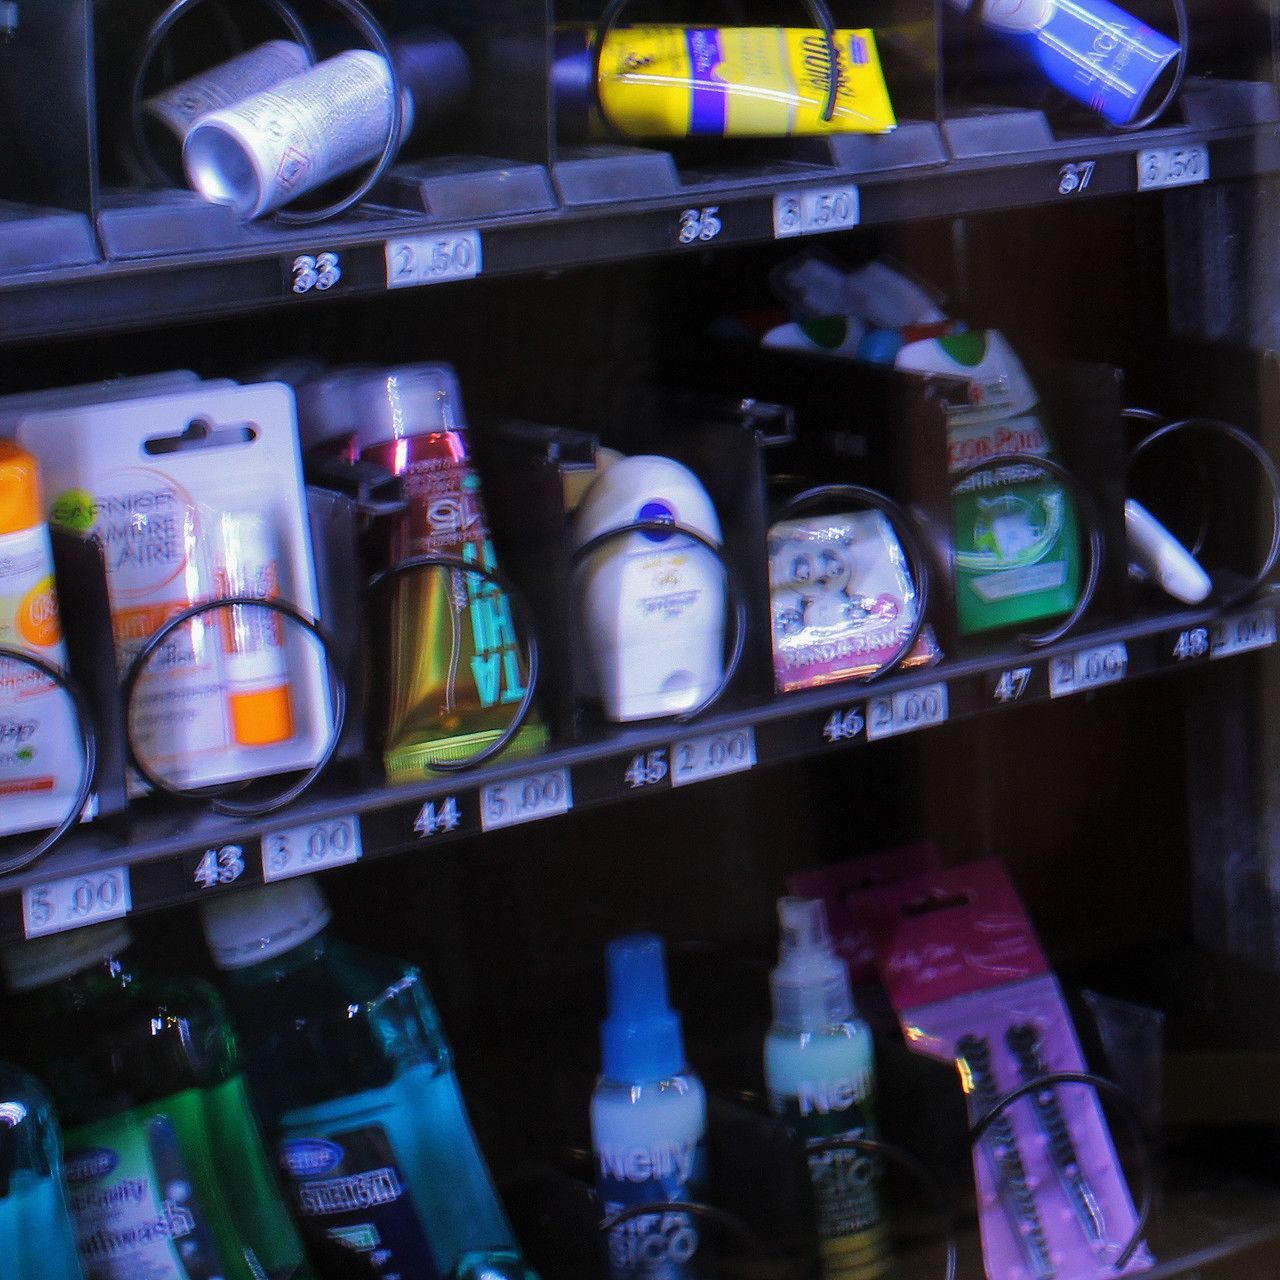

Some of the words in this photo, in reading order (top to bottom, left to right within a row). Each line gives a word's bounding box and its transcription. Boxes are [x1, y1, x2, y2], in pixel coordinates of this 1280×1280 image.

[1058, 160, 1096, 195] 37
[678, 206, 722, 244] 35
[292, 252, 342, 294] 33
[994, 667, 1033, 702] 47
[823, 707, 864, 741] 46
[625, 749, 669, 789] 45
[413, 796, 462, 838] 44
[194, 843, 246, 889] 43
